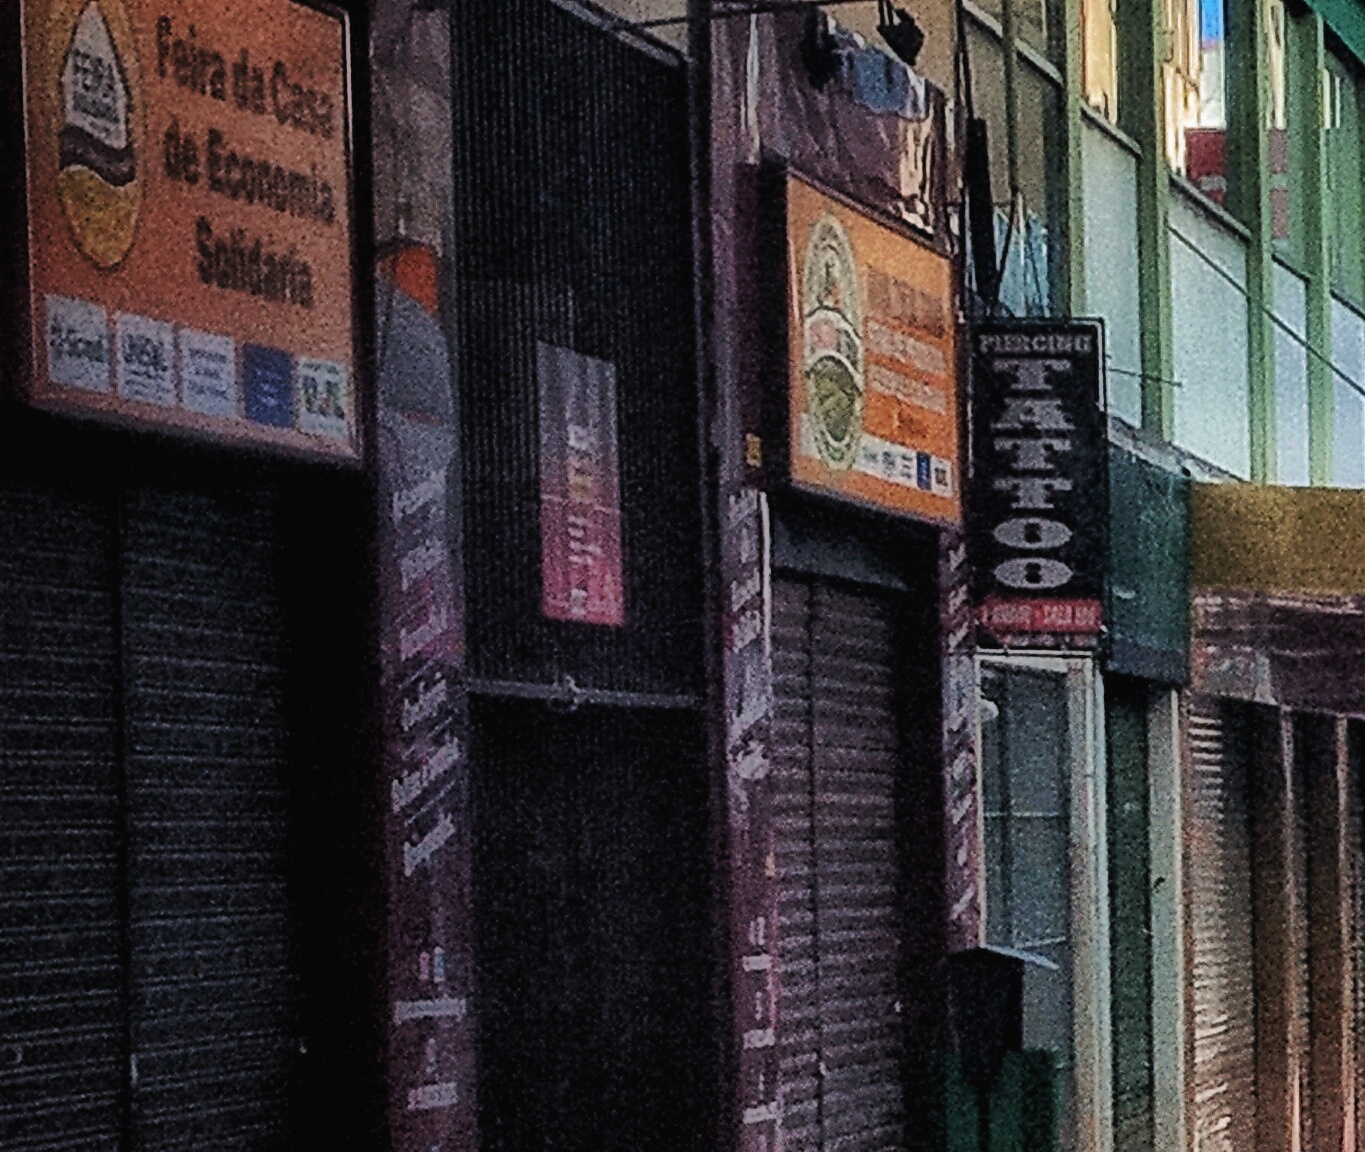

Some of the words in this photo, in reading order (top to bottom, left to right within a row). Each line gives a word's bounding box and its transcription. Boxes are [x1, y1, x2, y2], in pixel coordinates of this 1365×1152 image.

[156, 15, 225, 101] Feira
[233, 49, 266, 115] da
[271, 60, 333, 139] Casa
[164, 114, 199, 185] de
[207, 128, 334, 225] Economia
[979, 332, 1093, 354] PIERCING
[990, 358, 1076, 590] TATTOO
